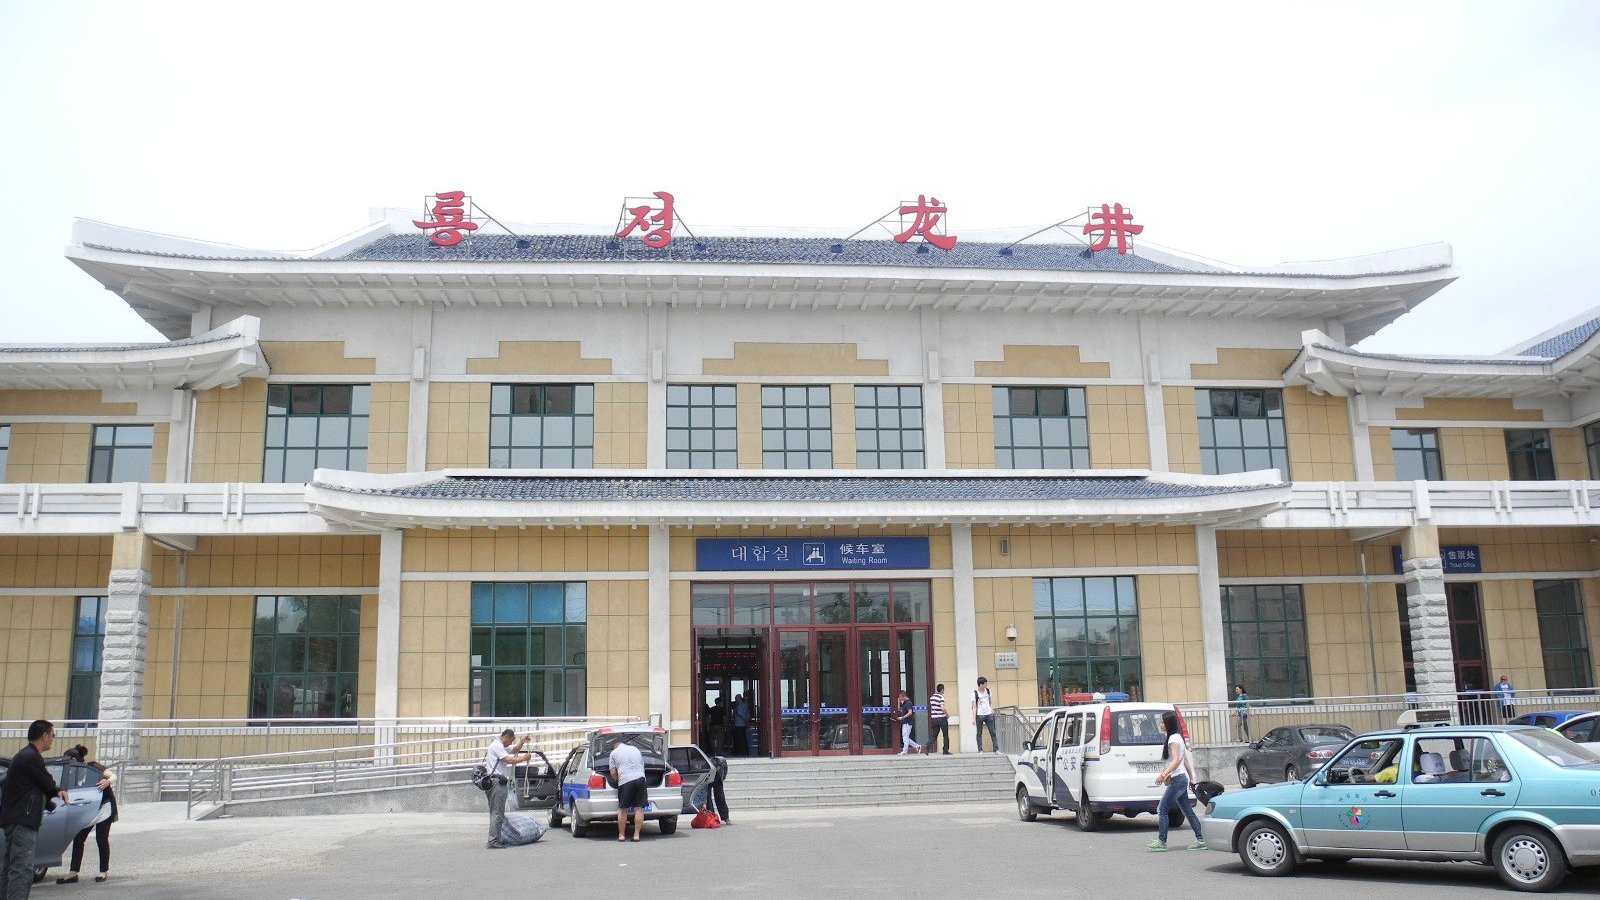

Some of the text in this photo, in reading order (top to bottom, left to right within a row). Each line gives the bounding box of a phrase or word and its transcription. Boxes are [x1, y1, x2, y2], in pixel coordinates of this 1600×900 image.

[730, 545, 789, 562] 대합실
[839, 542, 886, 555] 候车室
[841, 556, 888, 566] Waiting Room
